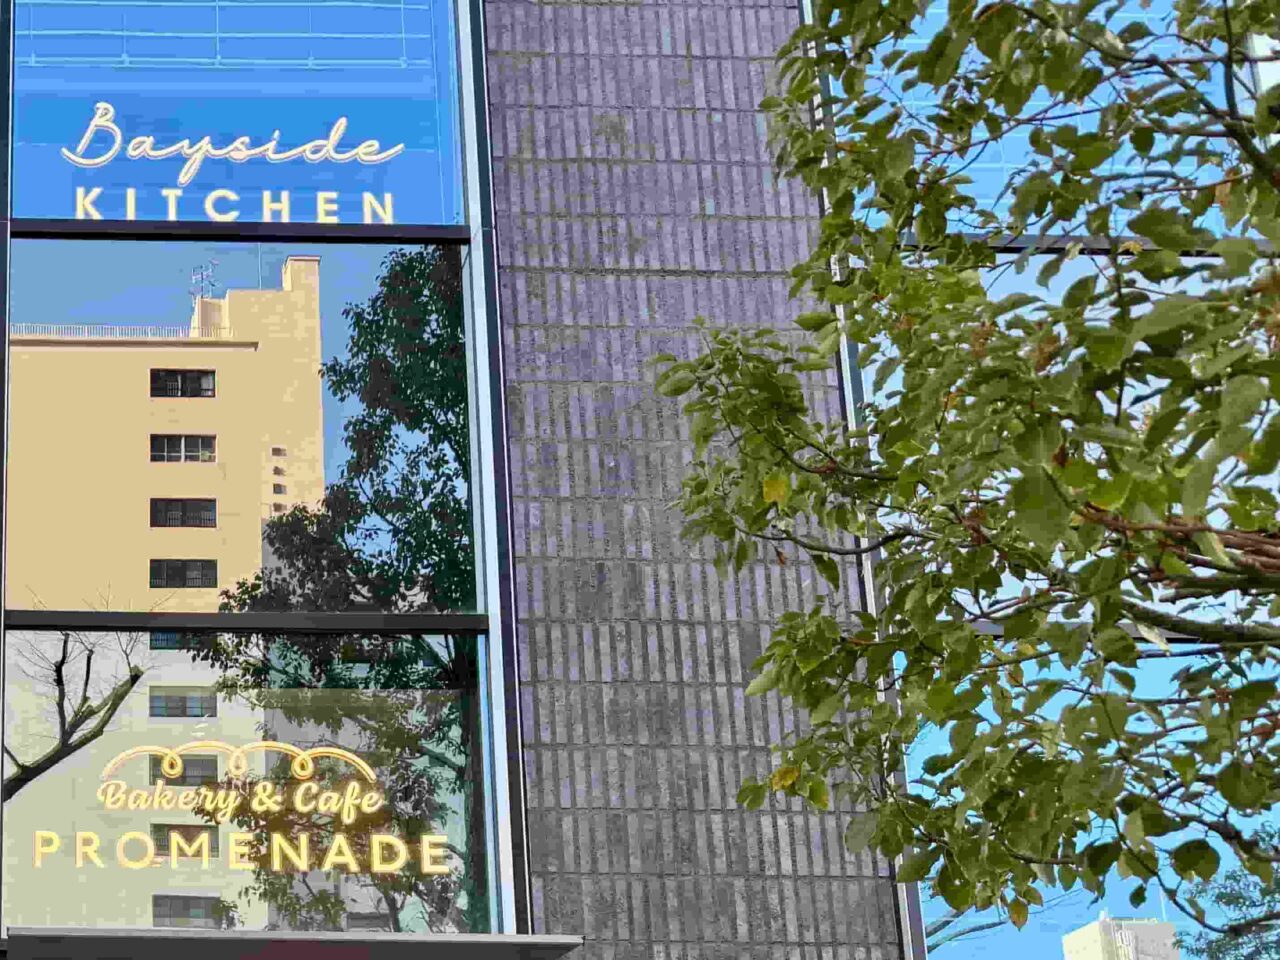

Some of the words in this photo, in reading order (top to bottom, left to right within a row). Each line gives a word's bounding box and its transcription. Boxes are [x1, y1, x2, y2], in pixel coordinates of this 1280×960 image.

[61, 101, 405, 187] Bayside
[74, 186, 396, 225] KITCHEN
[96, 779, 241, 824] Bakery
[251, 781, 283, 813] &
[294, 781, 384, 825] Cafe
[32, 830, 451, 875] PROMENADE
